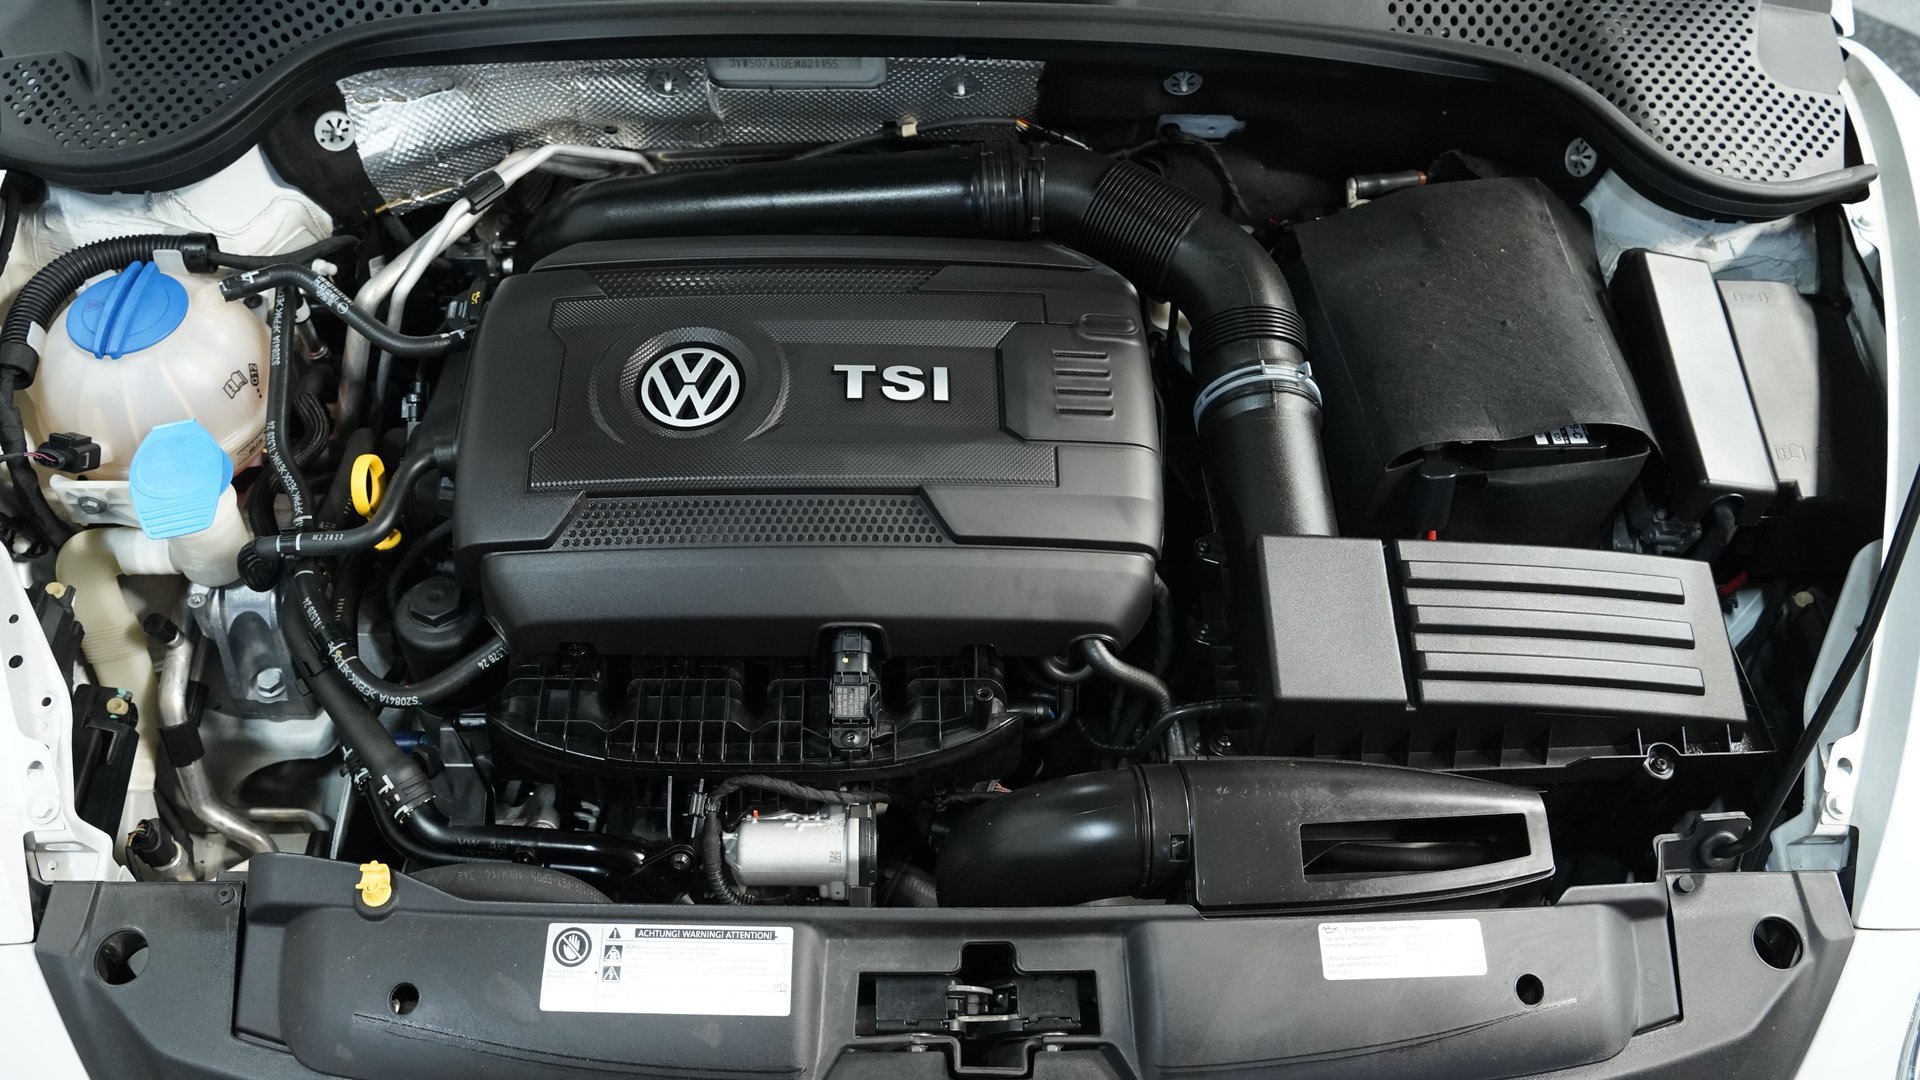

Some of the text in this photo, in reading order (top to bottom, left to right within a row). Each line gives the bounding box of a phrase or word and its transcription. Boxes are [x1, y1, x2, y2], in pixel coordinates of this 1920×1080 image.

[833, 364, 949, 402] TSI
[379, 693, 419, 706] S20841A
[638, 929, 773, 940] ACHTUNG! WARNING! ATTENTION!
